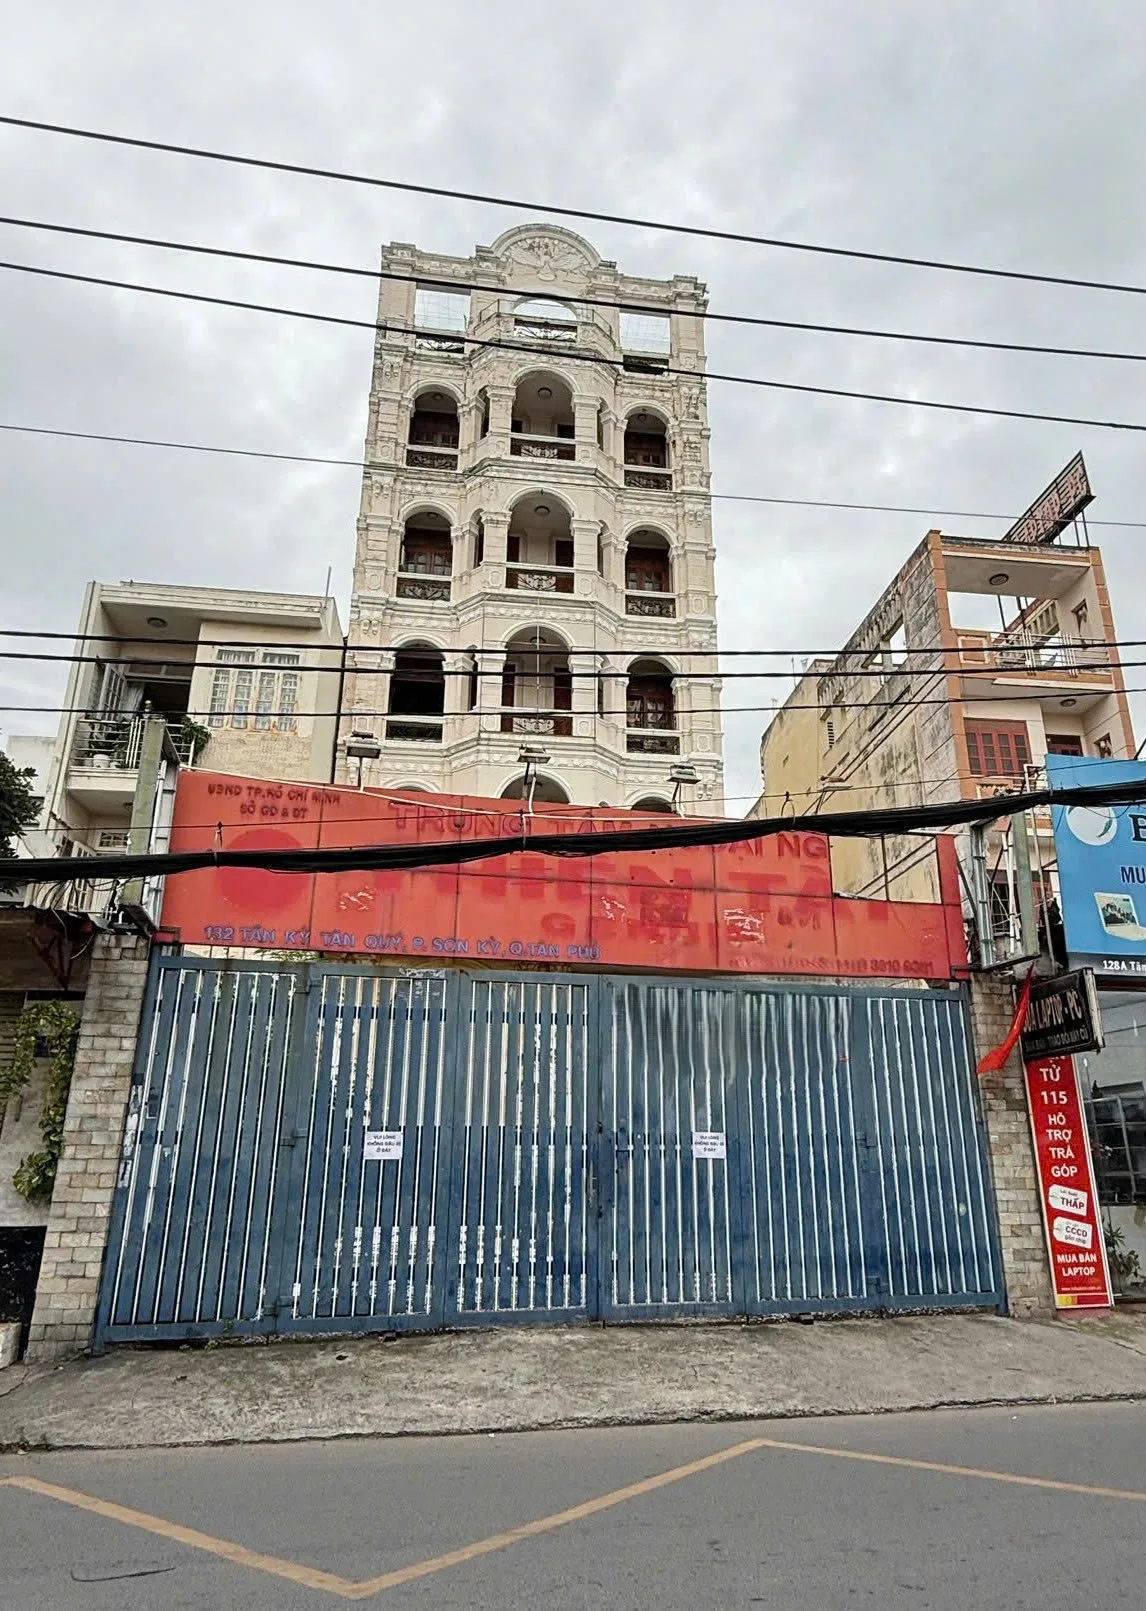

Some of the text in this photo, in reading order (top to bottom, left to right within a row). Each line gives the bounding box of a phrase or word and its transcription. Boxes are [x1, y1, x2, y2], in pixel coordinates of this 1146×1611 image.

[205, 926, 235, 941] 132
[1103, 960, 1128, 971] 128A
[1041, 1091, 1068, 1105] 115
[1046, 1129, 1072, 1143] TRỢ
[1049, 1145, 1075, 1159] TRẢ
[1051, 1163, 1078, 1177] GÓP
[1060, 1197, 1085, 1209] THẤP
[1065, 1226, 1088, 1238] CCCD
[1057, 1251, 1097, 1263] MUA BÁN
[1062, 1266, 1096, 1277] LAPTOP
